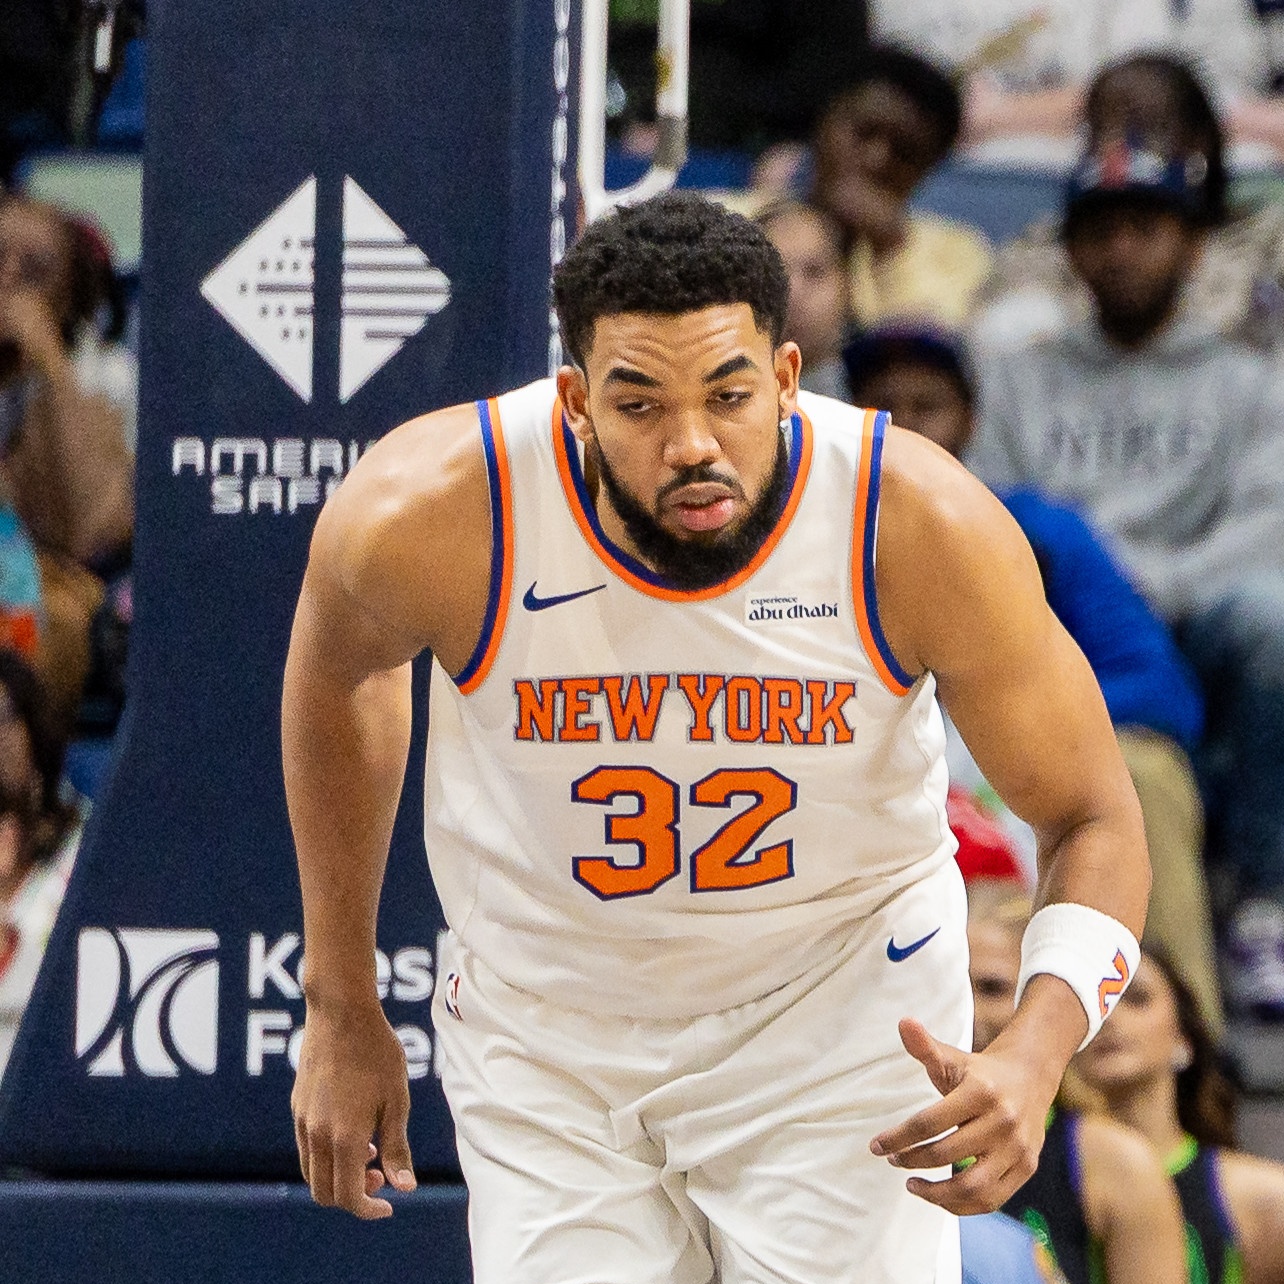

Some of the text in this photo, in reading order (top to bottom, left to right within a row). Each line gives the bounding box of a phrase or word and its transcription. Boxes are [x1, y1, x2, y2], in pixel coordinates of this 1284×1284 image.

[172, 437, 378, 476] AMERI
[211, 476, 345, 515] SAF
[749, 606, 783, 620] abu
[750, 596, 798, 605] experience
[514, 674, 857, 745] NEW YORK
[571, 765, 798, 901] 32
